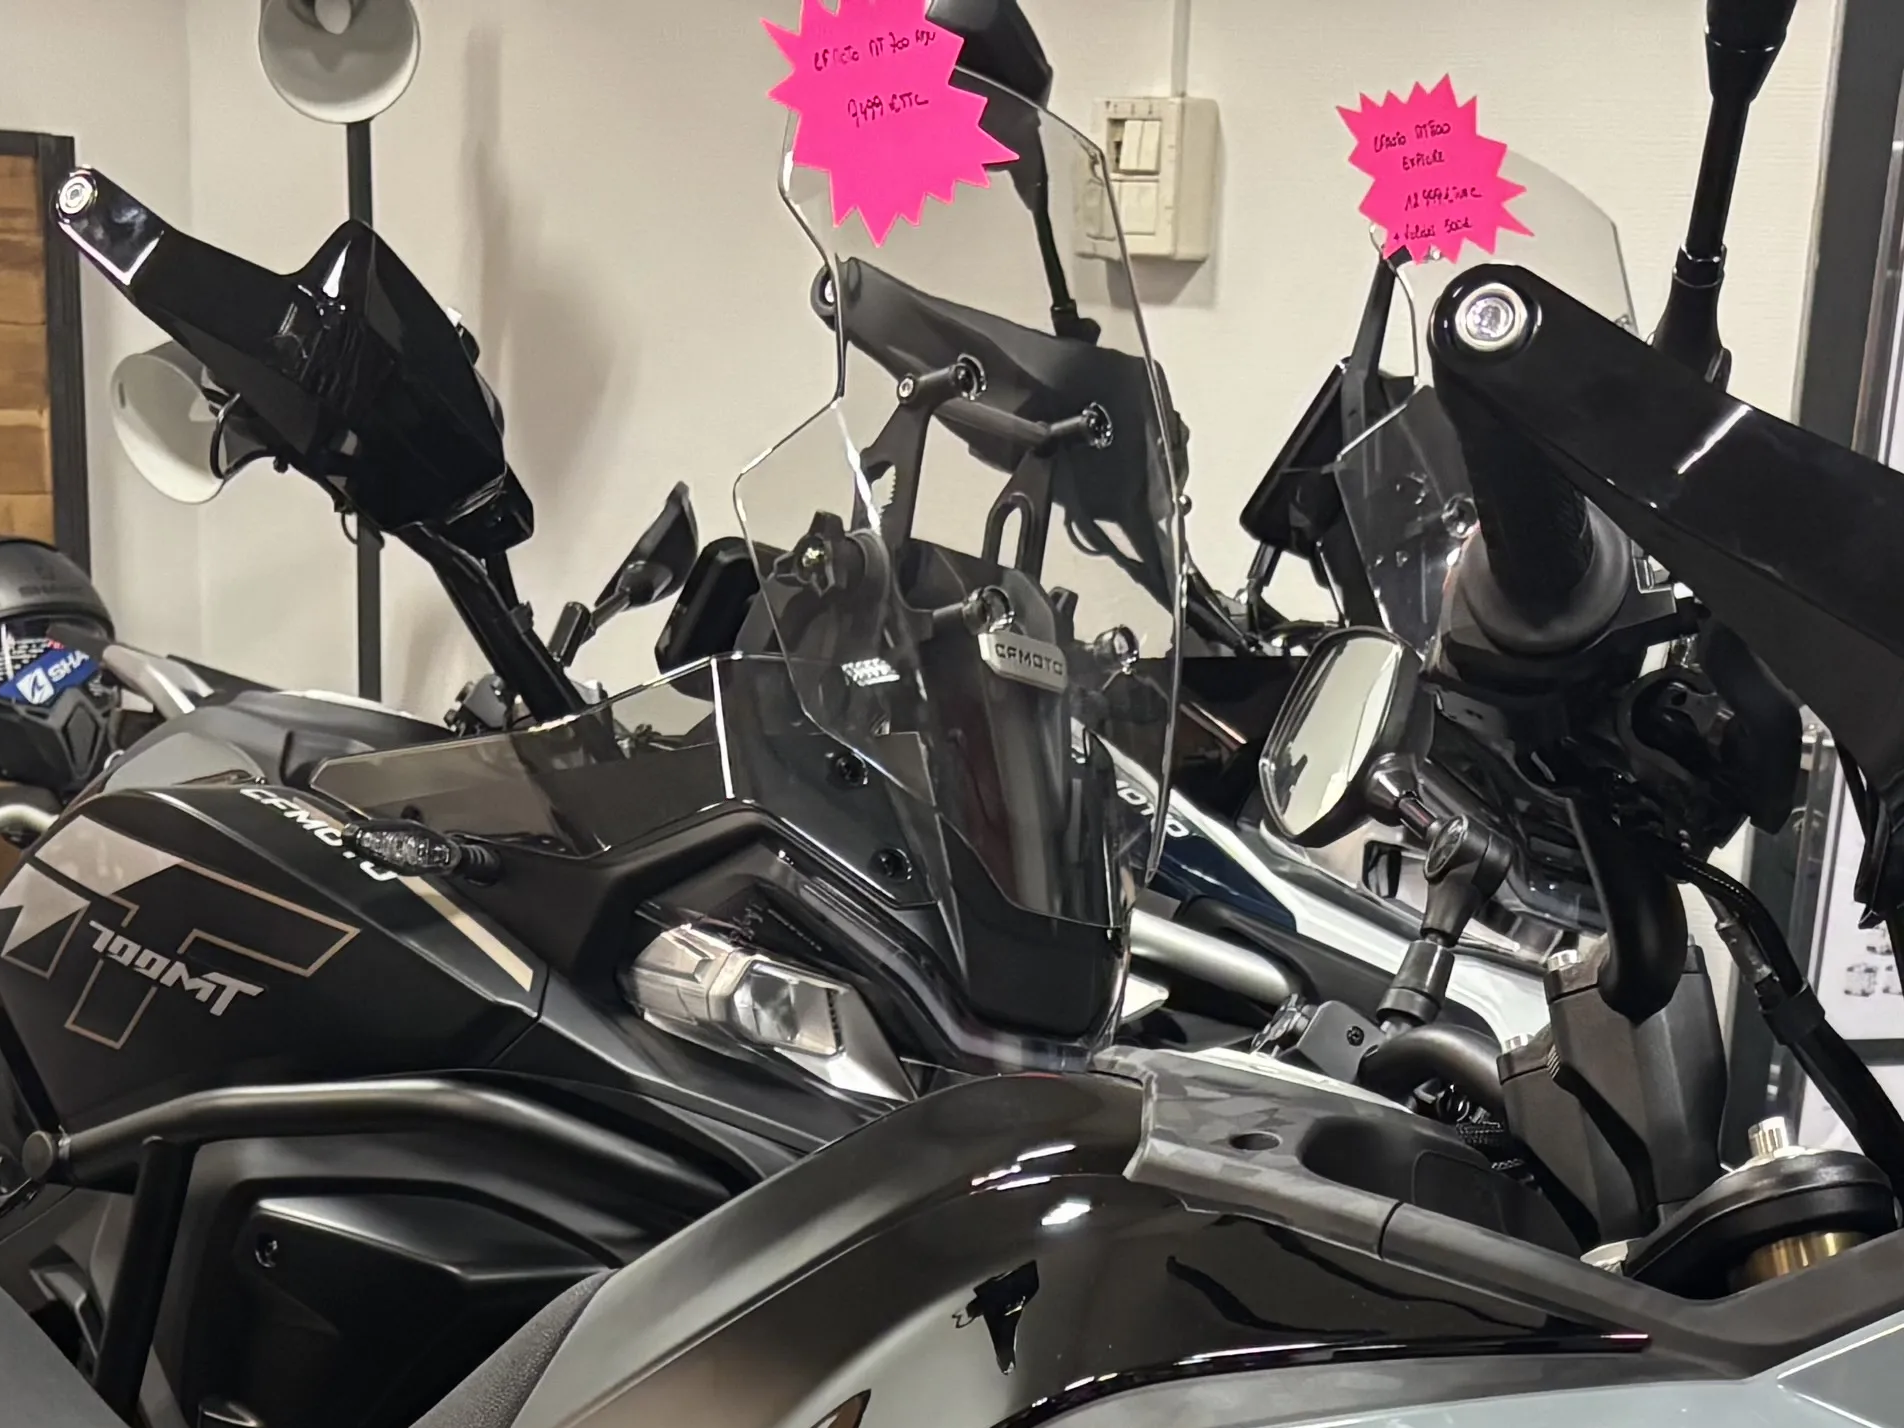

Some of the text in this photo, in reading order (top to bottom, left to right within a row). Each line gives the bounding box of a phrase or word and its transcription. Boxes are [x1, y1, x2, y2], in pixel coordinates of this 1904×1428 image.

[45, 648, 88, 685] SHA
[995, 643, 1064, 677] CFMOTO
[240, 787, 399, 882] CFMOO
[89, 920, 265, 1016] 700MT
